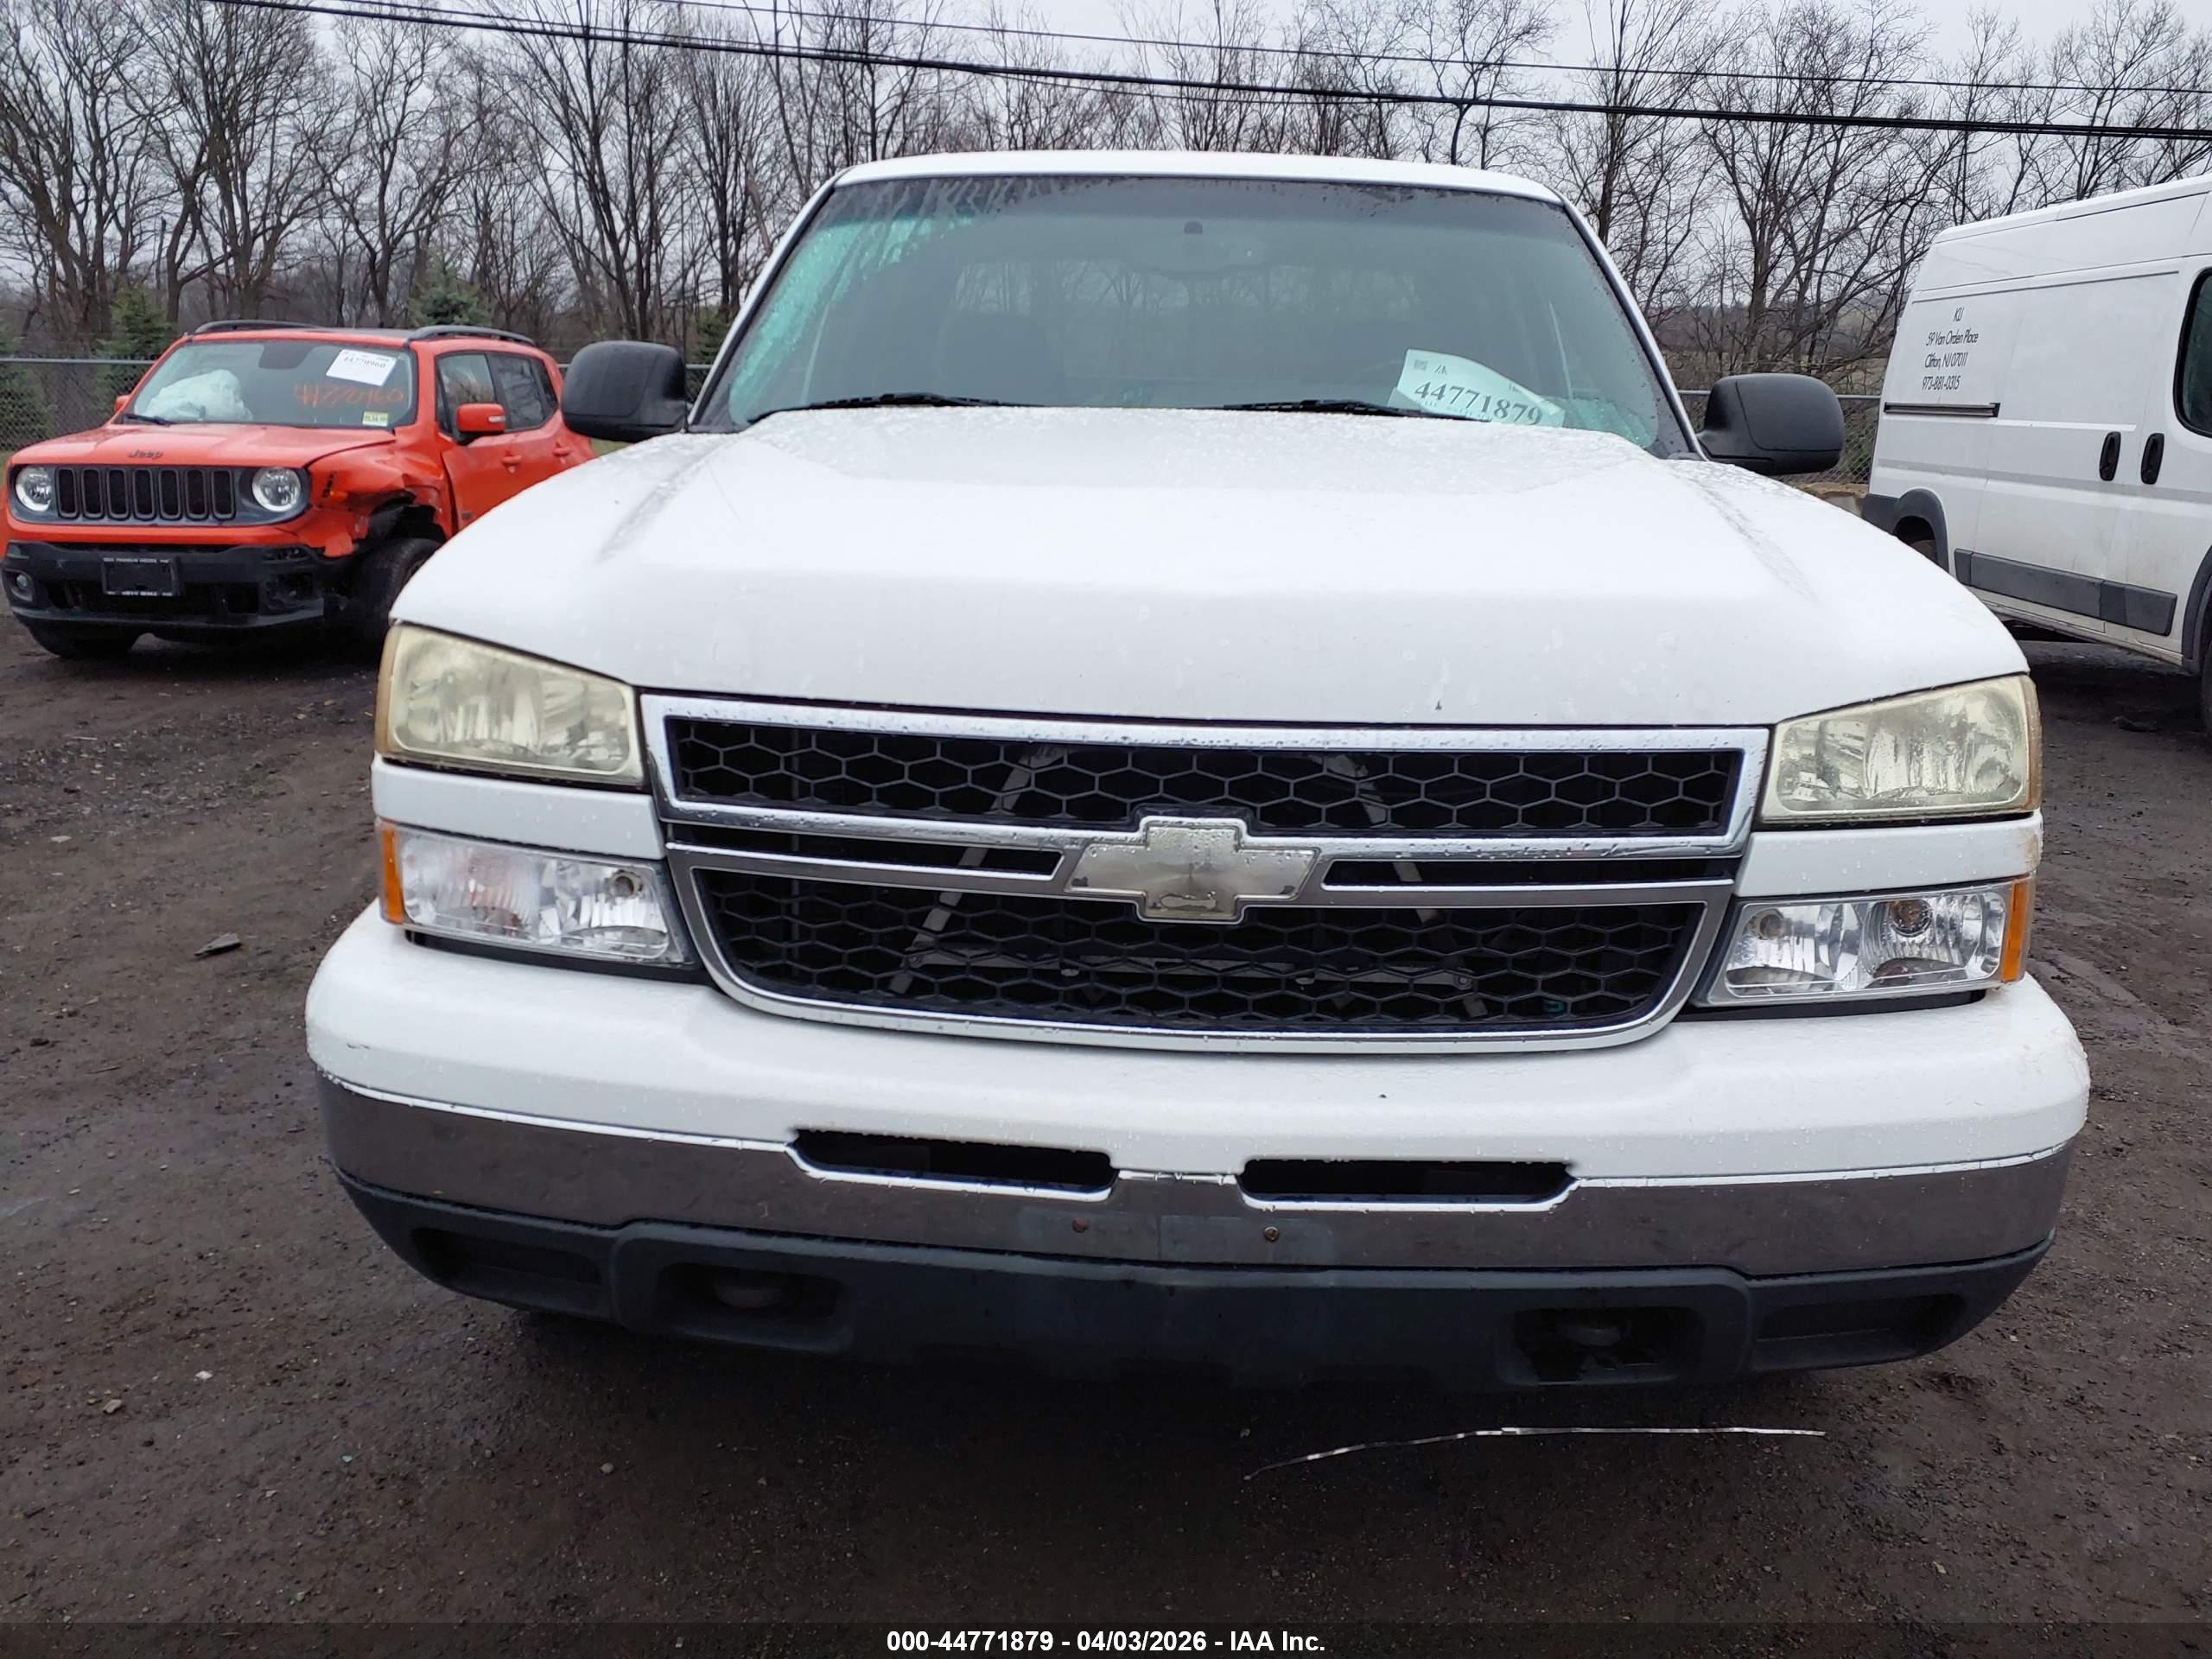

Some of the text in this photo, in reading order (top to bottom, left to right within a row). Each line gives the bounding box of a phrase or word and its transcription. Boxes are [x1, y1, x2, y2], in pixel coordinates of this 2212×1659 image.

[1926, 327, 1979, 346] 59 Van Orden Place
[1942, 352, 1952, 367] NJ
[1951, 352, 1968, 367] 07011
[1414, 380, 1543, 426] 44771879
